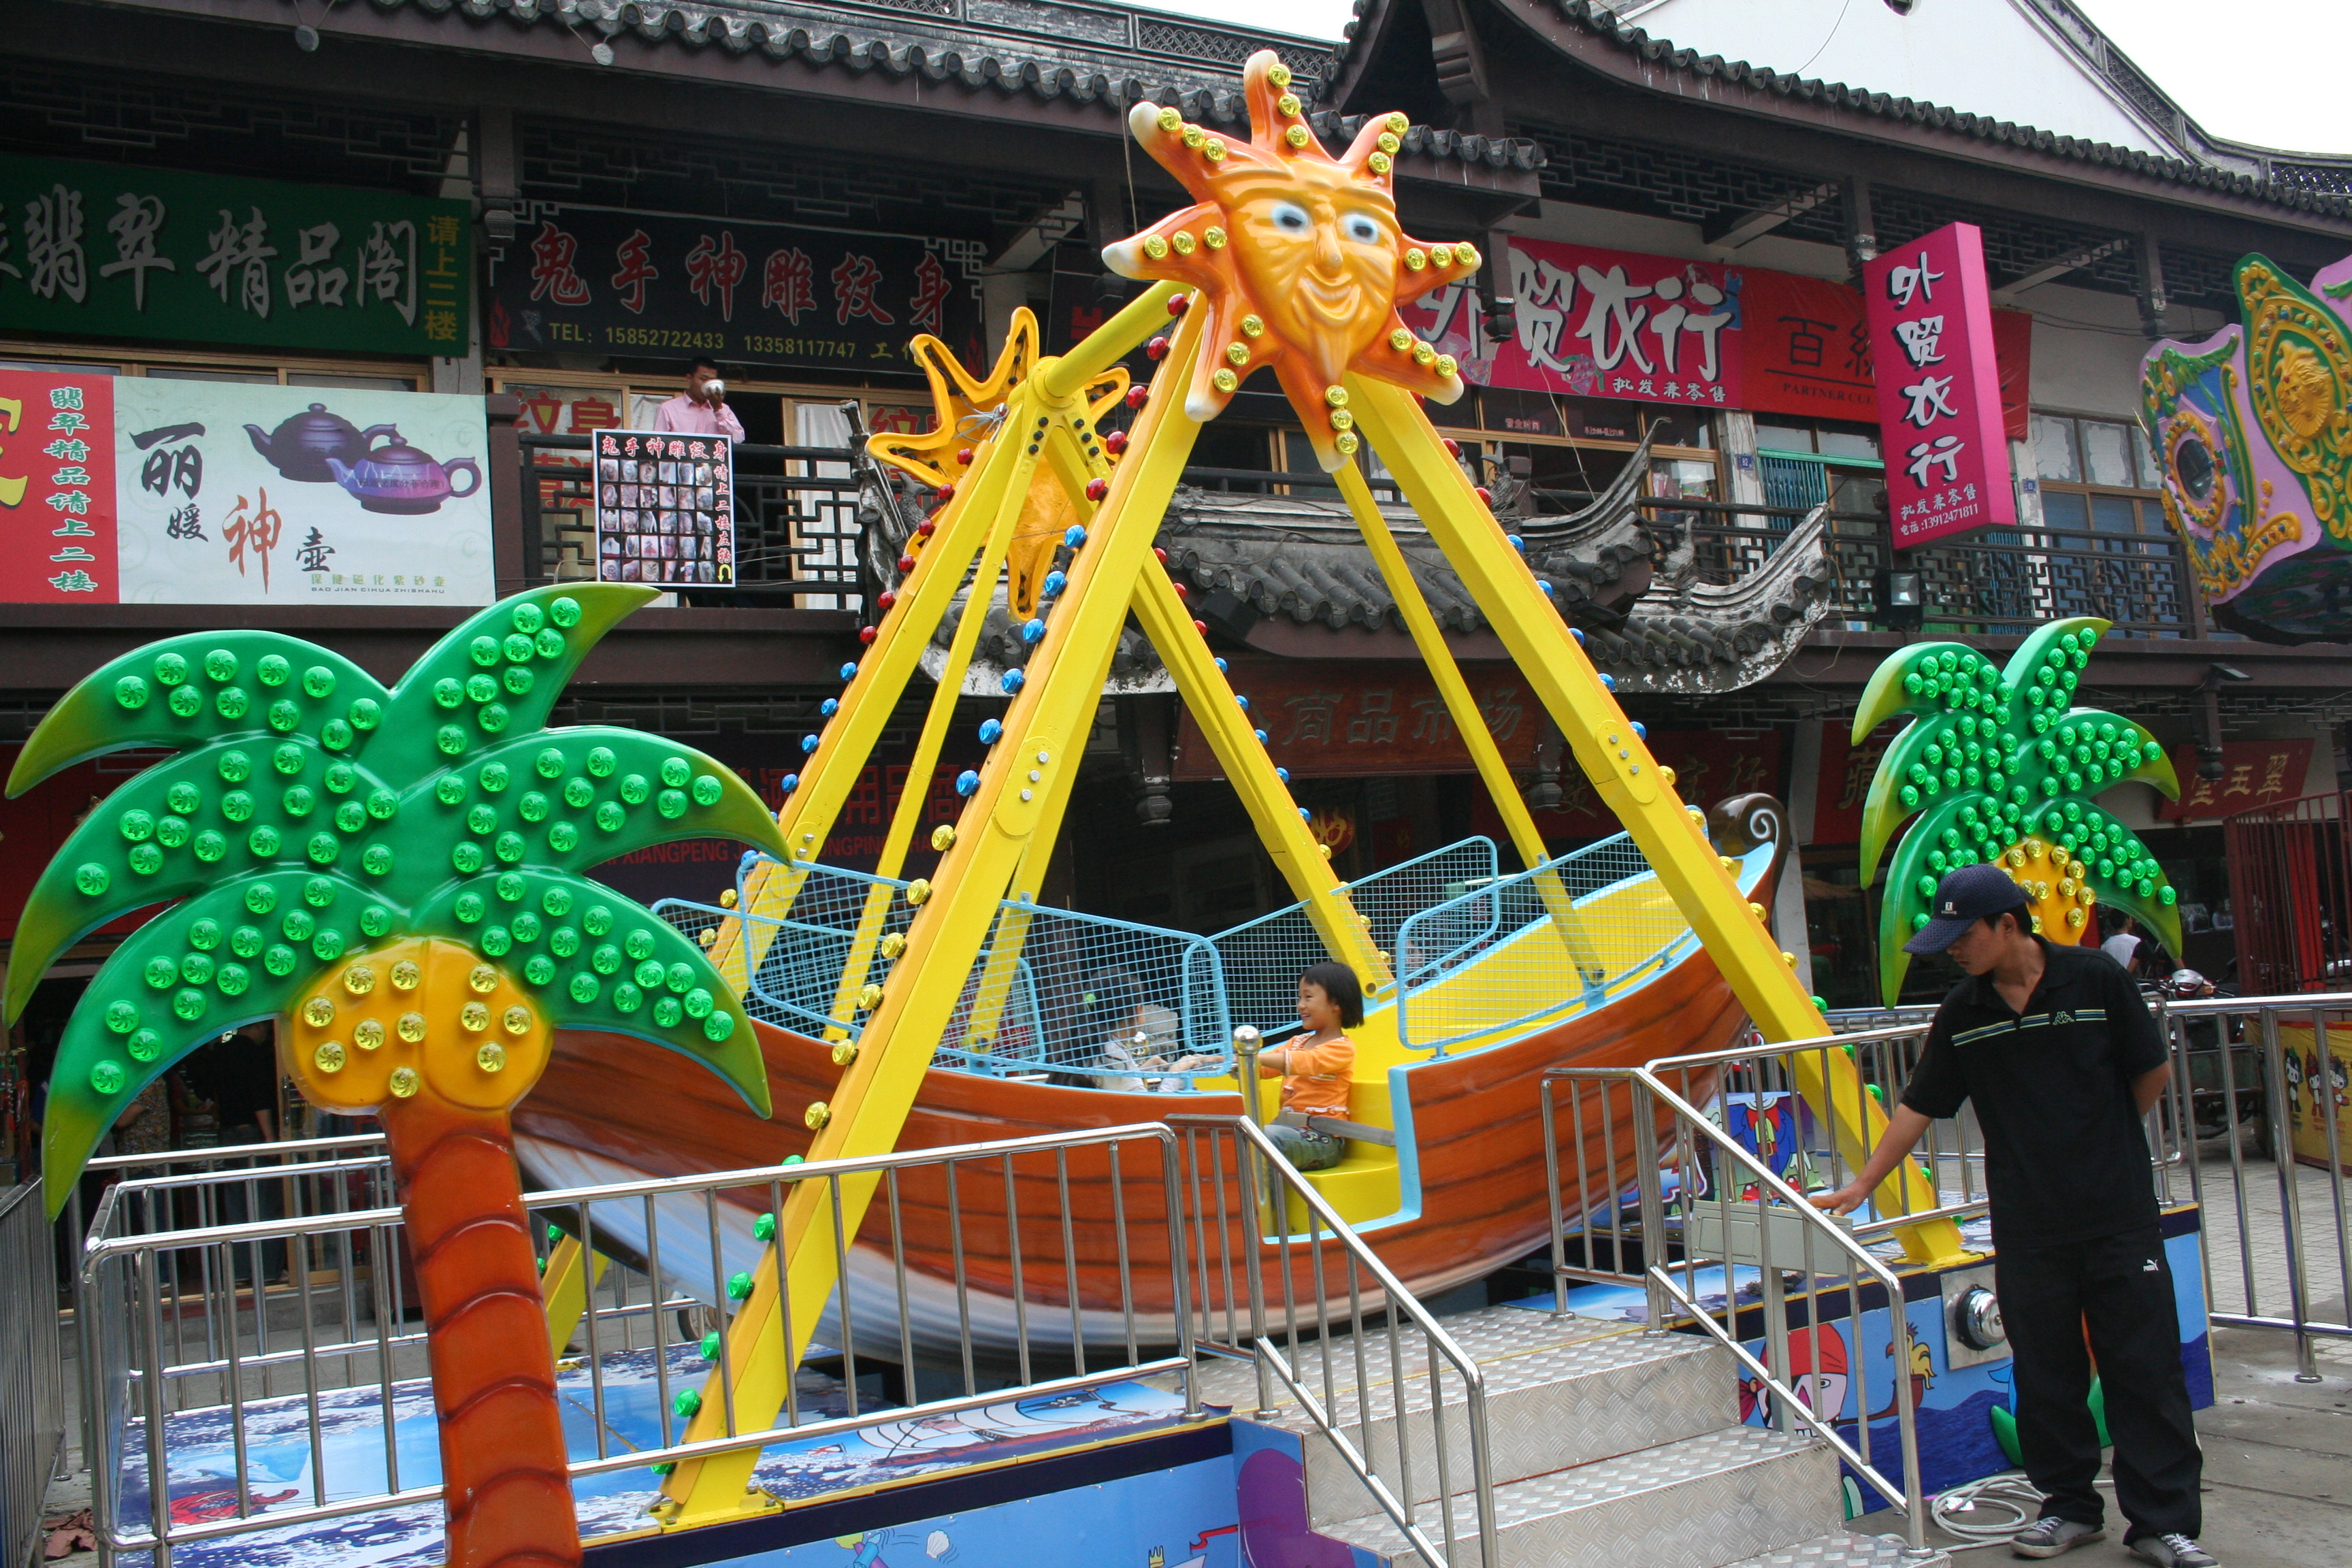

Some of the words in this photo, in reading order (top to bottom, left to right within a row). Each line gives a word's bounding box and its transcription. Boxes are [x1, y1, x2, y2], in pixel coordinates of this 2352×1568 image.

[425, 214, 460, 341] 请上二楼
[530, 220, 952, 337] 鬼手神雕纹身
[605, 327, 724, 349] 15852722433
[743, 336, 856, 359] 13358117747
[1612, 376, 1727, 404] 批发兼零售
[1891, 250, 1965, 487] 外贸衣行
[43, 387, 99, 593] 翡翠精品请上二楼
[602, 435, 728, 463] 鬼手神雕纹身
[713, 463, 732, 564] 请上二楼左转
[1900, 483, 1977, 521] 批发兼零售
